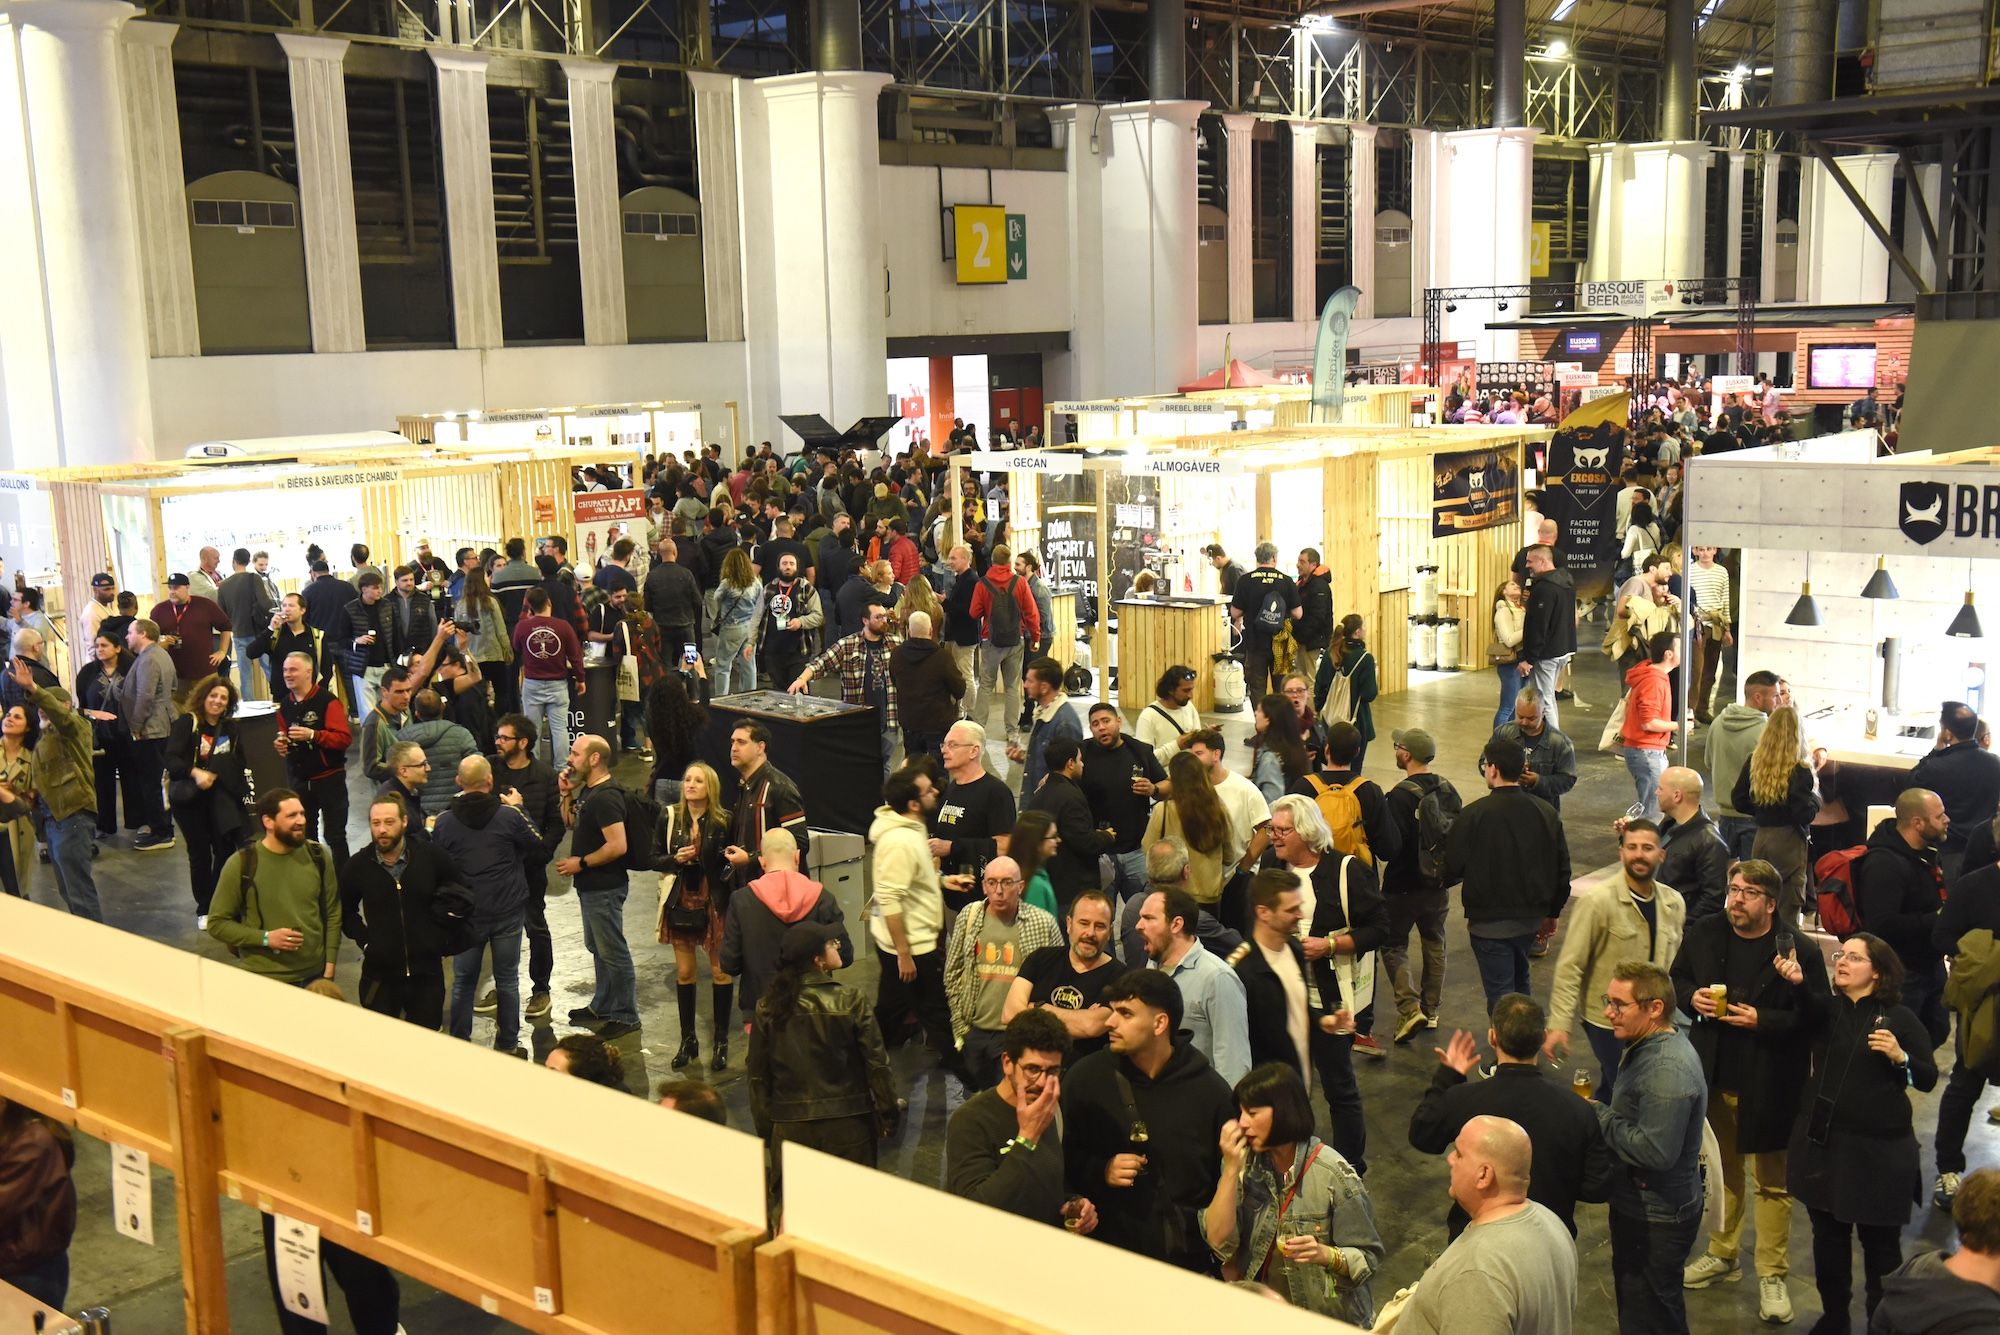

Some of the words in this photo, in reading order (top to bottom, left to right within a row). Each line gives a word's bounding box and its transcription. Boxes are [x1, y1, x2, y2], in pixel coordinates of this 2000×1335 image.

[972, 222, 991, 268] 2
[1531, 233, 1542, 267] 2
[1588, 282, 1644, 295] BASQUE
[1588, 295, 1619, 306] BEER
[1569, 337, 1597, 345] EUSKADI
[1325, 340, 1341, 392] Espiga
[1374, 367, 1396, 377] BAS
[1589, 388, 1616, 396] BASQUE
[594, 408, 629, 416] LINDEMANS
[1063, 404, 1089, 412] SALAMA
[1090, 404, 1120, 412] BREWING
[1165, 404, 1192, 412] BREBEL
[1194, 404, 1212, 412] BEER
[488, 412, 543, 422] WEIHENSTEPHAN
[1013, 457, 1047, 469] GECAN
[1152, 458, 1220, 473] ALMOGÀVER
[287, 474, 314, 489] BIÈRES
[314, 476, 320, 487] &
[321, 474, 354, 487] SAVEURS
[355, 472, 365, 484] DE
[366, 470, 398, 483] CHAMBLY
[1570, 473, 1606, 483] EXCOSA
[0, 478, 29, 490] GULLONS
[577, 498, 610, 509] CHUPATE
[608, 495, 642, 514] JÀPI
[1047, 519, 1072, 540] DÓNA
[1569, 528, 1600, 536] TERRACE
[1087, 541, 1095, 558] A
[1567, 551, 1594, 560] BUISÁN
[1060, 560, 1087, 577] TEVA
